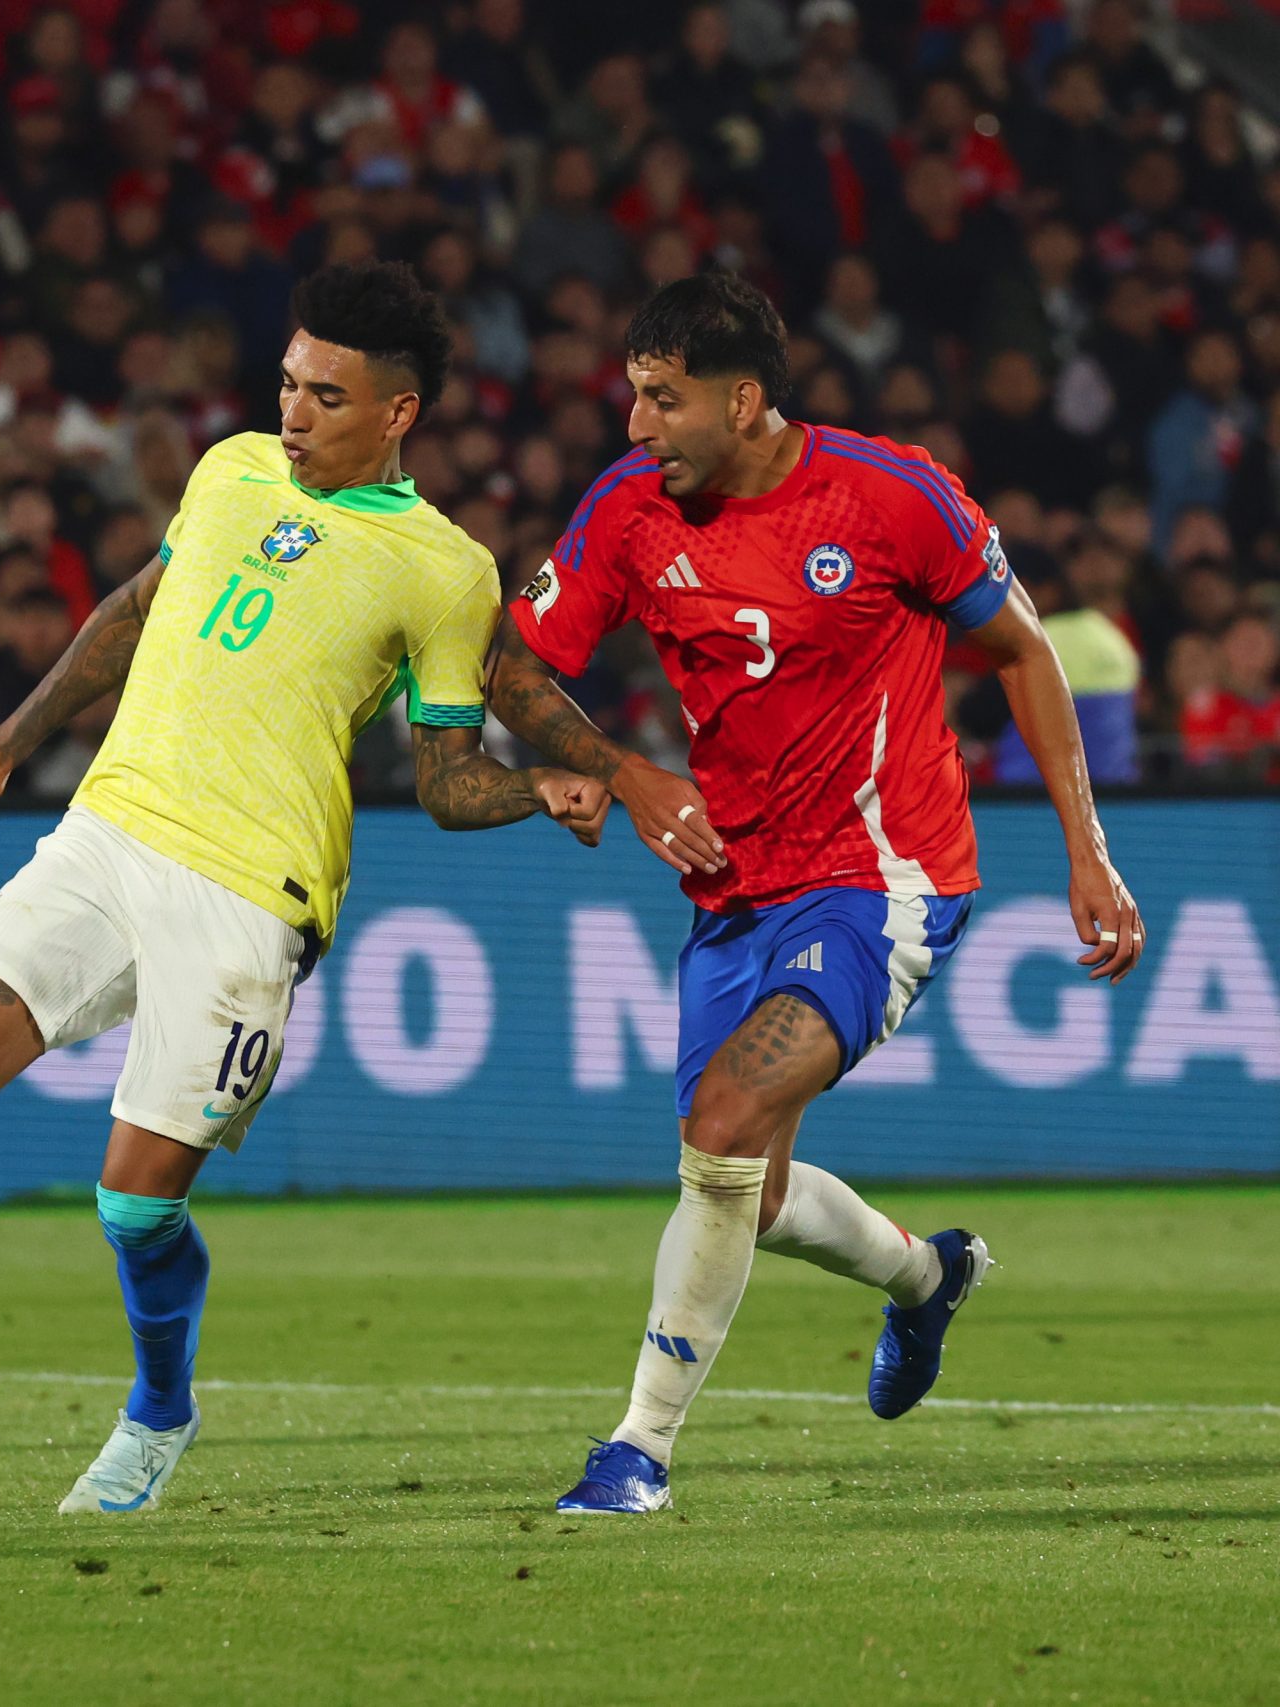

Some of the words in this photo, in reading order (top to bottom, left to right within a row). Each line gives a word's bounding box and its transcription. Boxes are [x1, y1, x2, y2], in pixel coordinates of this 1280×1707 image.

[242, 554, 289, 582] BRASIL
[281, 534, 300, 545] CBF
[197, 573, 274, 652] 19
[734, 607, 776, 679] 3
[214, 1021, 270, 1100] 19
